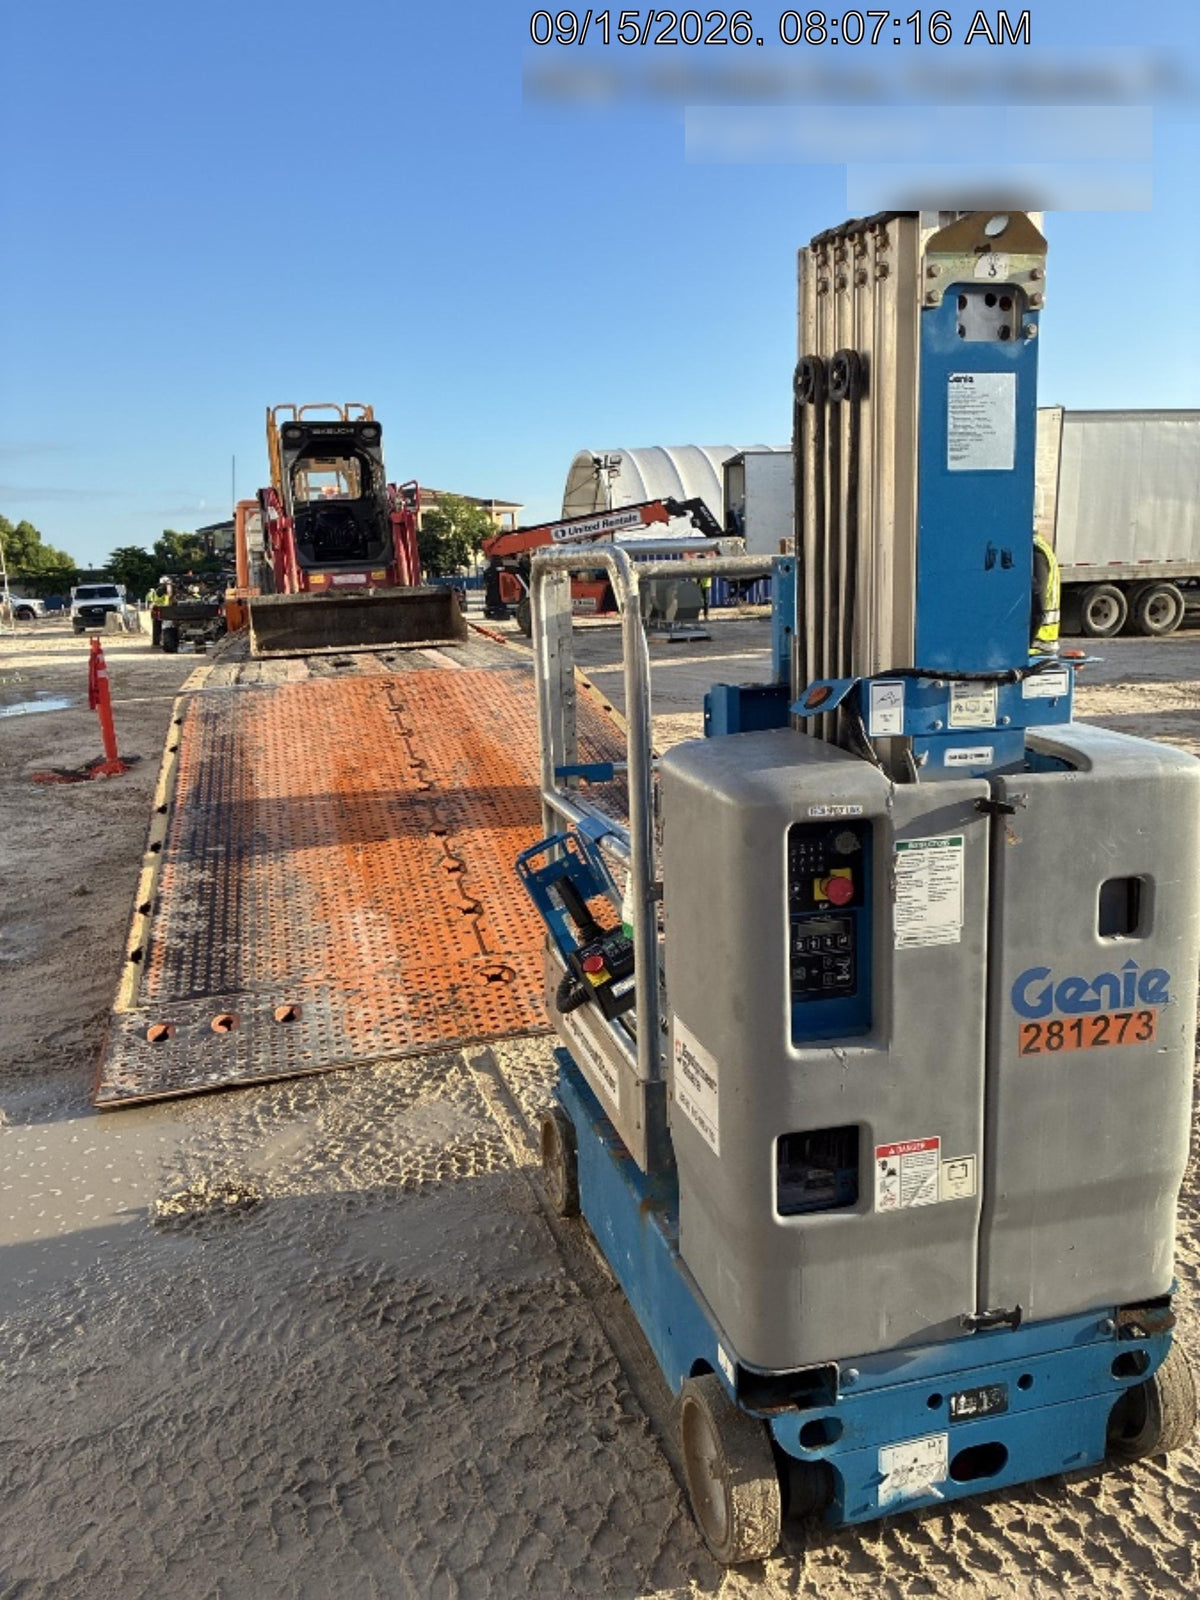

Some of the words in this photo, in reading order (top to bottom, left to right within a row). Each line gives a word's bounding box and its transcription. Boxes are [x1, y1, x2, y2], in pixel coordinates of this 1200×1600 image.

[568, 520, 600, 536] United
[602, 513, 638, 529] Rentals
[1010, 957, 1171, 1020] Genie
[1021, 1010, 1154, 1055] 281273
